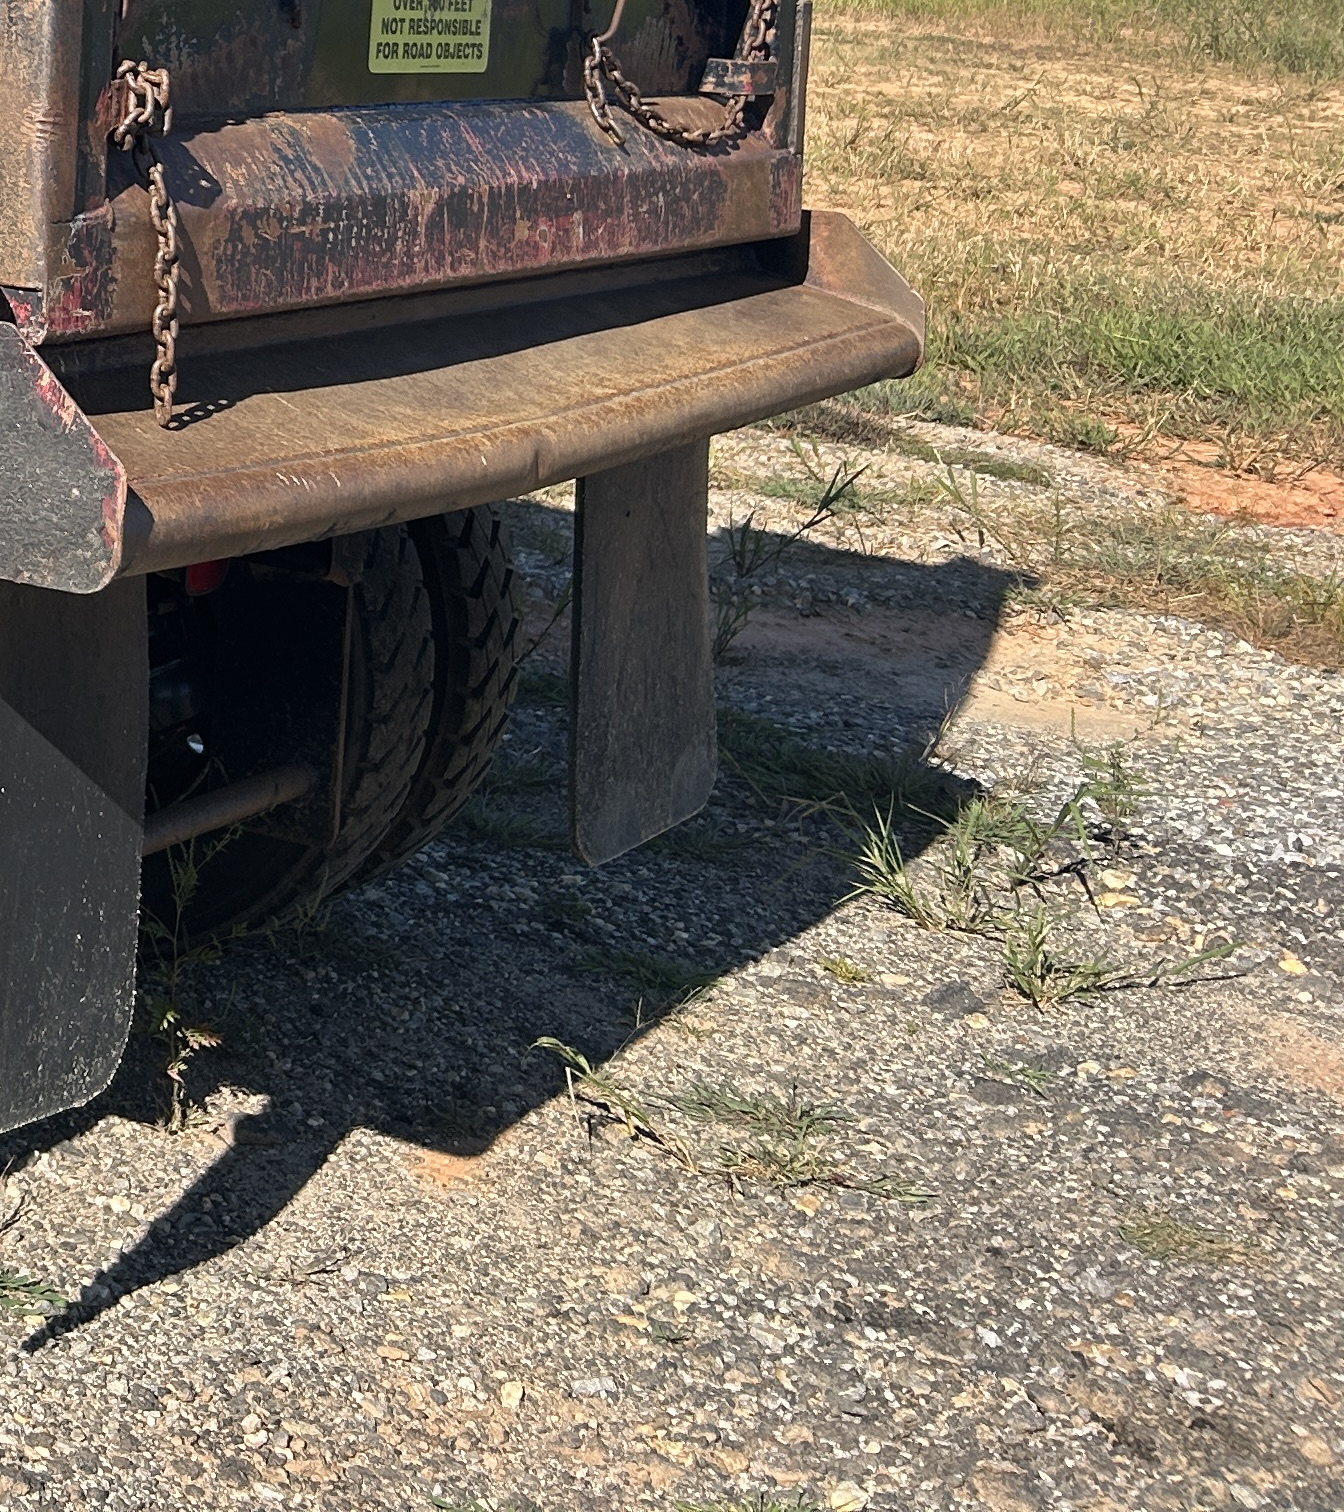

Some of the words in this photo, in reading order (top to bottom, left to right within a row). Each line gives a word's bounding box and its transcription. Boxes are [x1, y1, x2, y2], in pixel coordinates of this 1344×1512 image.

[381, 17, 406, 36] NOT
[408, 17, 482, 36] RESPONSIBLE
[375, 41, 399, 60] FOR
[402, 42, 433, 60] ROAD
[435, 42, 484, 60] OBJECTS
